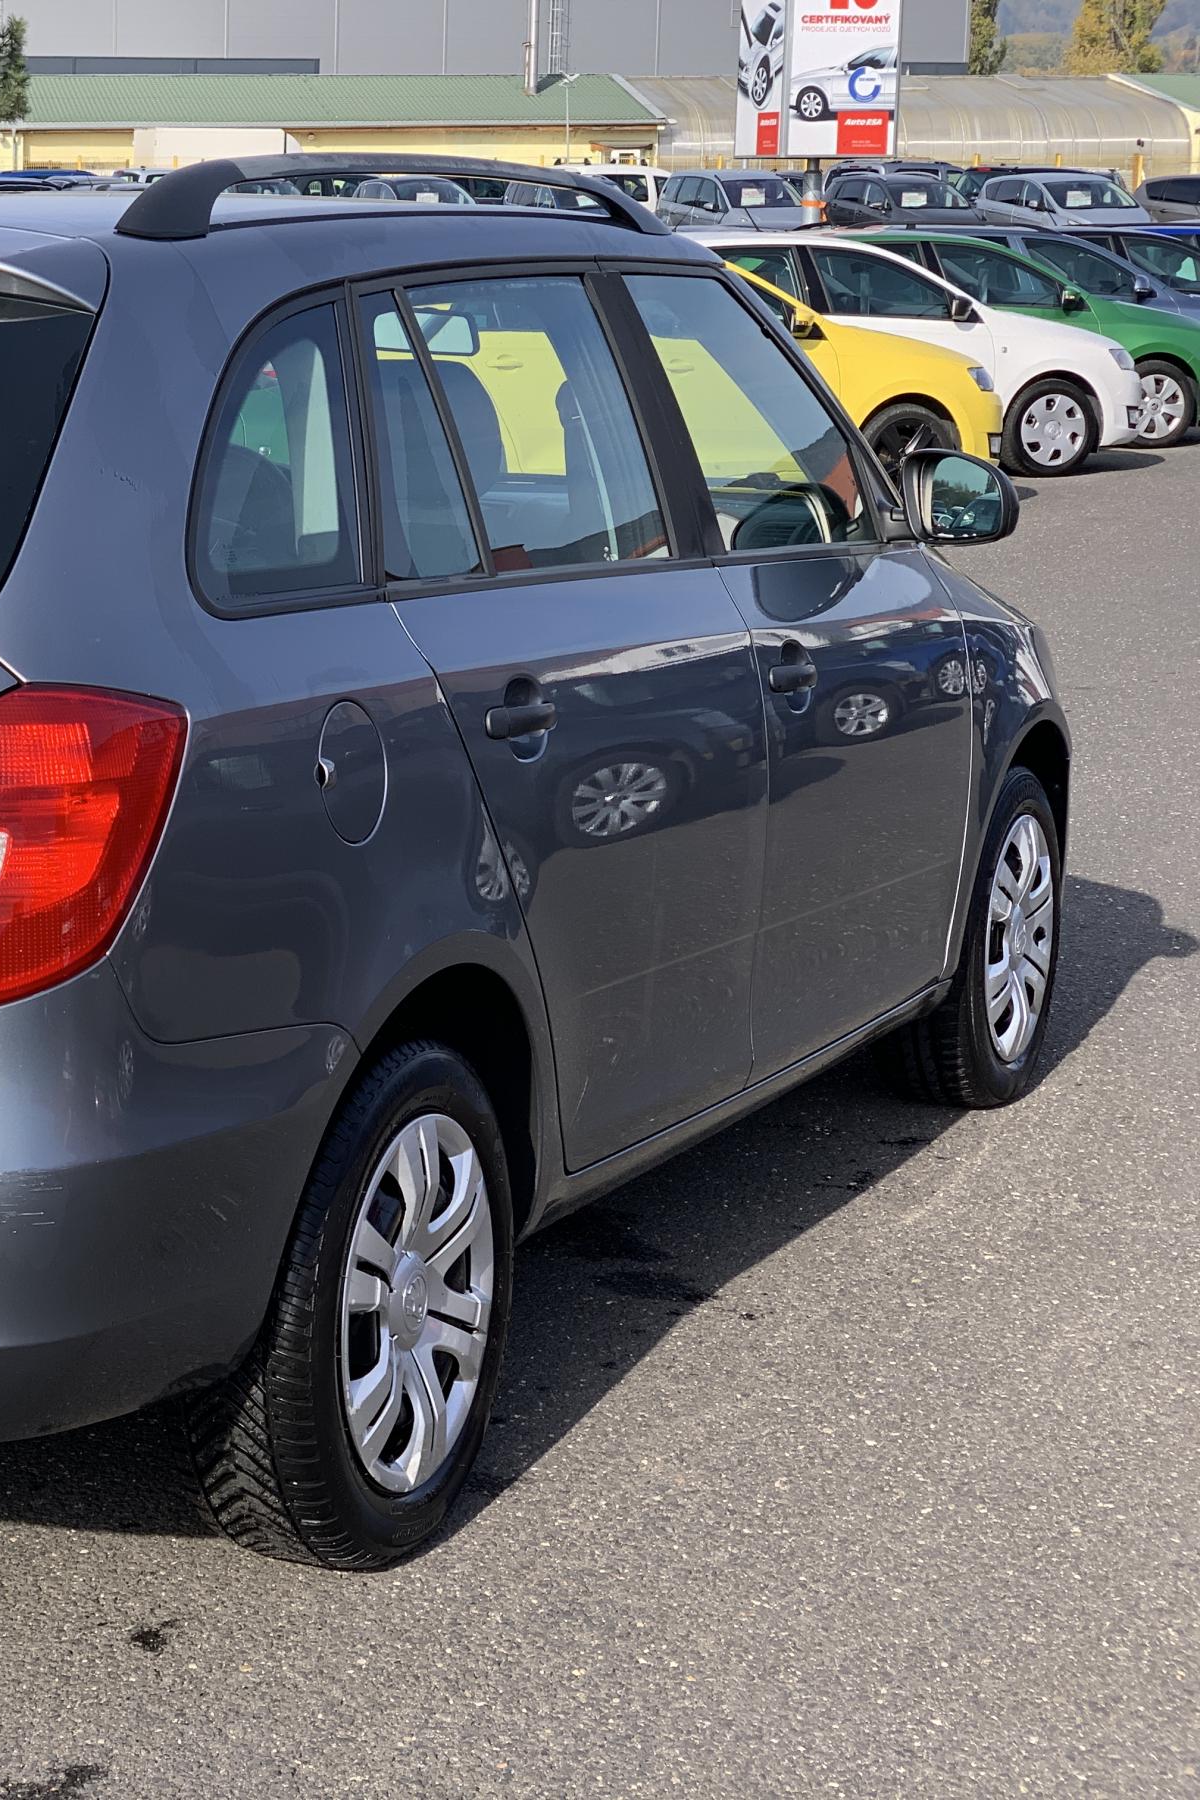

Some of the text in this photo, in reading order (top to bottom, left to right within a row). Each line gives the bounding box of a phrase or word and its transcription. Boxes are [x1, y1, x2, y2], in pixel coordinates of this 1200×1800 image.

[801, 13, 891, 24] CERTIFIKOVANÝ
[844, 118, 883, 126] Auto ESA
